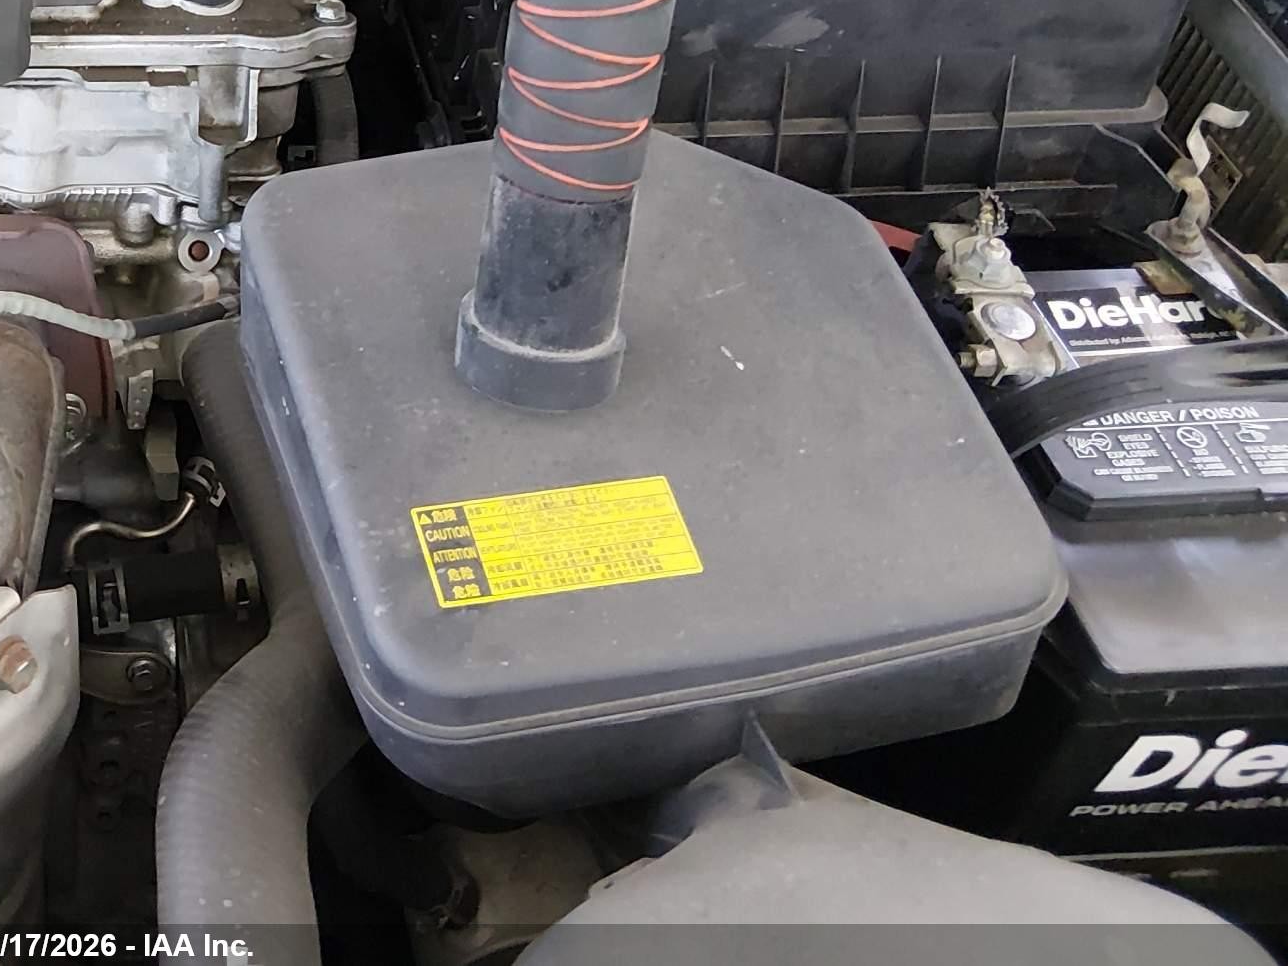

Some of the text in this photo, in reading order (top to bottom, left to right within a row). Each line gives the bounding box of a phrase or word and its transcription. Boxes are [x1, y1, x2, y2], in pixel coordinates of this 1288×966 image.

[1048, 296, 1224, 329] DieHar
[1099, 406, 1260, 426] DANGER / POISON
[425, 525, 471, 542] CAUTION
[433, 546, 478, 563] ATTENTION
[1095, 729, 1288, 792] Die
[1069, 796, 1288, 817] POWER AHEA
